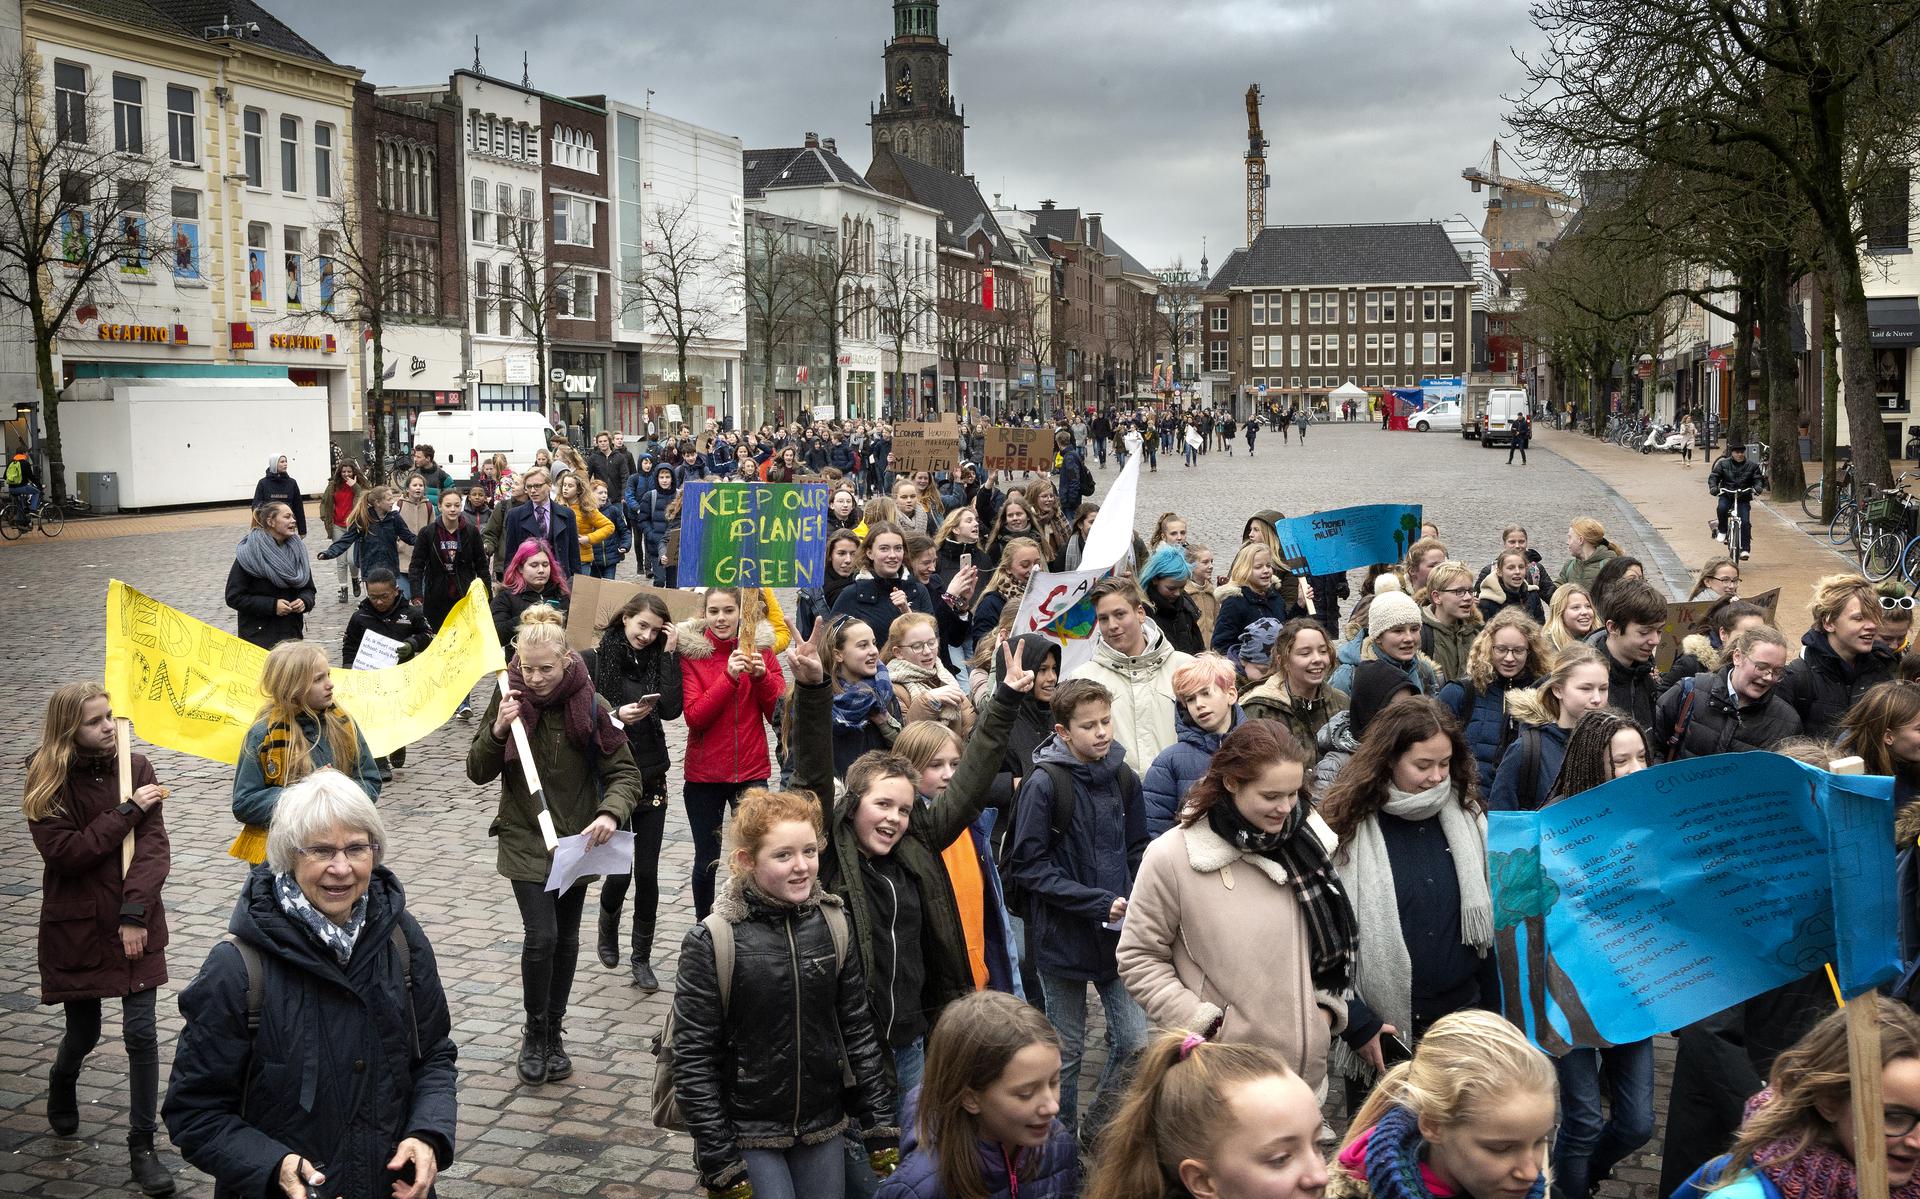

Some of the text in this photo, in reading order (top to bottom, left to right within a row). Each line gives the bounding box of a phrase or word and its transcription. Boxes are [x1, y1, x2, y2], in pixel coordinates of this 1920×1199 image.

[99, 323, 168, 342] SCAPINO
[272, 333, 321, 349] SCAPINO
[411, 355, 426, 371] Etos
[563, 375, 596, 392] ONLY
[999, 430, 1036, 443] RED
[1006, 444, 1028, 456] DE
[985, 456, 1050, 472] WERELD
[699, 488, 827, 519] KEEP OUR
[715, 555, 813, 585] GREEN
